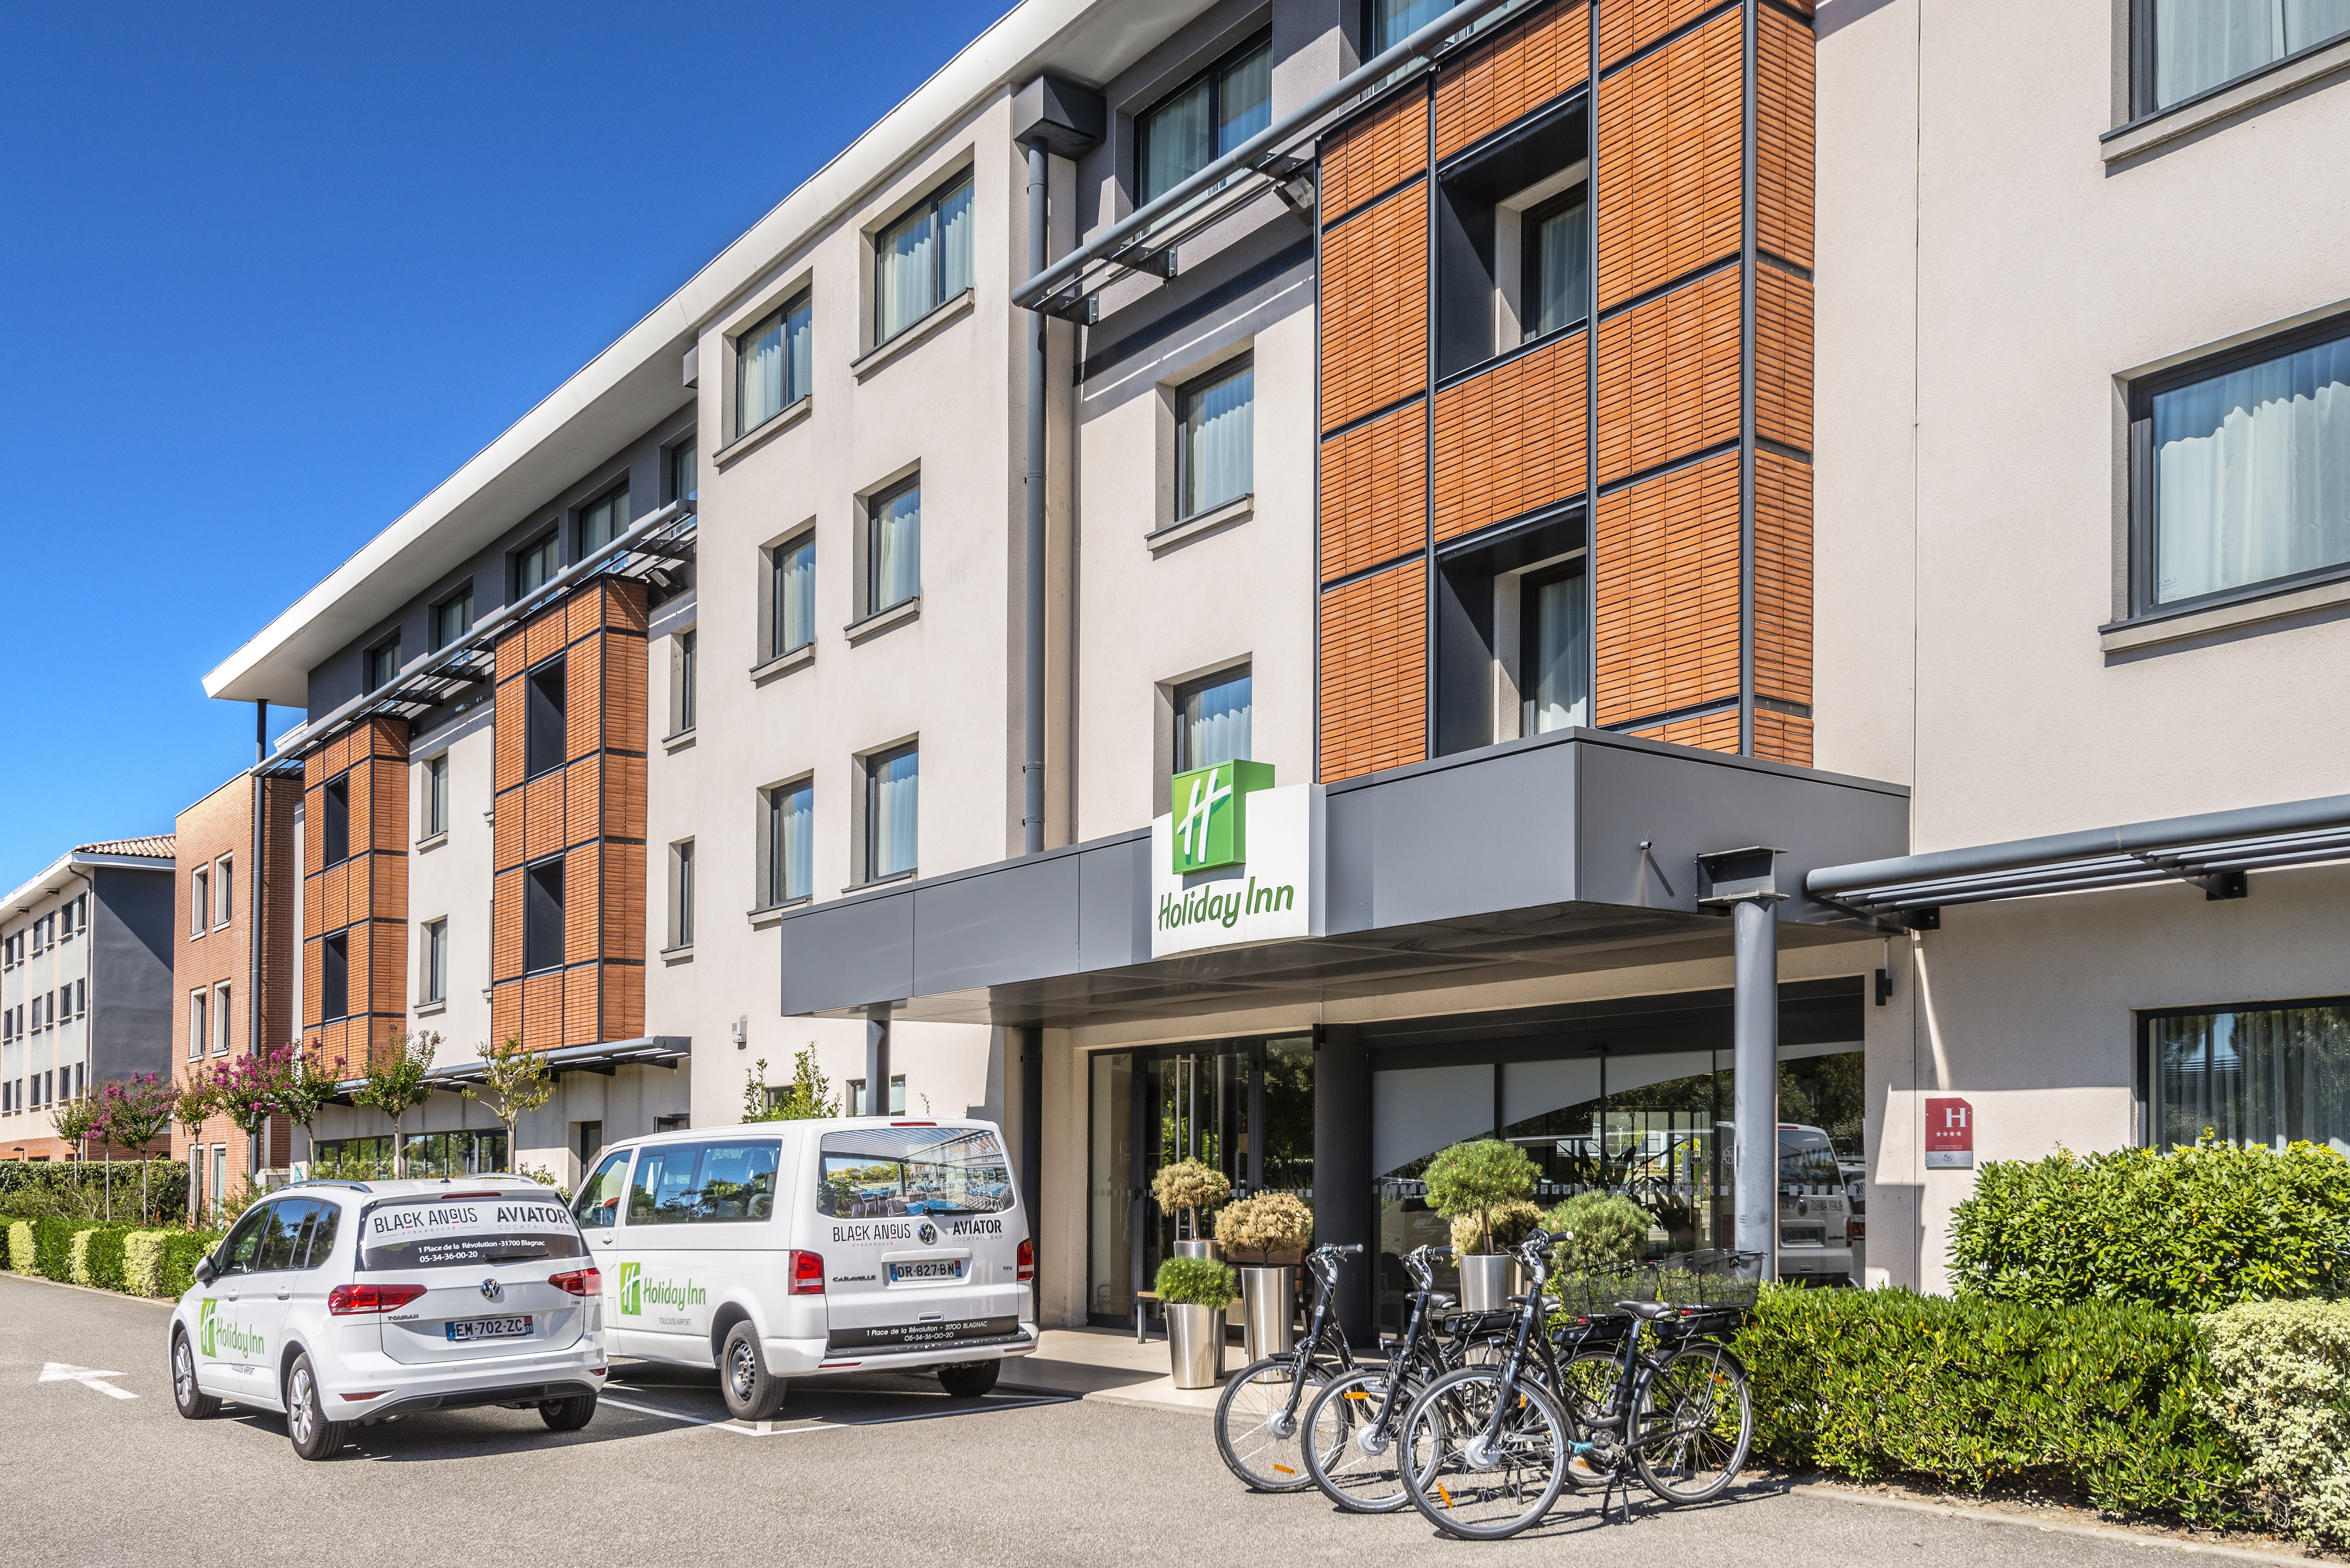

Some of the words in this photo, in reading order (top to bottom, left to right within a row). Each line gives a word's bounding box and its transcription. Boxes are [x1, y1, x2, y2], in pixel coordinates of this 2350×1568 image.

[1158, 885, 1241, 932] Holiday
[1245, 876, 1295, 915] Inn
[1944, 1107, 1968, 1128] H
[374, 1211, 425, 1233] BLACK
[428, 1207, 478, 1226] ANGUS
[496, 1207, 570, 1225] AVIATOR
[402, 1226, 456, 1235] STEAKHOUSE
[832, 1225, 871, 1242] BLACK
[874, 1223, 911, 1240] ANGUS
[952, 1219, 1002, 1235] AVIATOR
[462, 1240, 498, 1248] Révolution
[419, 1250, 478, 1263] 05-34-36-00-20
[897, 1263, 955, 1278] DR-827-BN
[643, 1277, 686, 1311] Holiday
[687, 1278, 706, 1305] Inn
[455, 1318, 523, 1337] EM-702-ZC
[526, 1324, 533, 1332] 31
[659, 1317, 676, 1325] TOULOUSE
[676, 1318, 691, 1326] AIRPORT
[909, 1325, 938, 1334] Révolution
[963, 1321, 988, 1329] BLAGNAC
[216, 1317, 249, 1359] Holiday
[250, 1324, 265, 1355] Inn
[904, 1331, 954, 1342] 05-34-36-00-20
